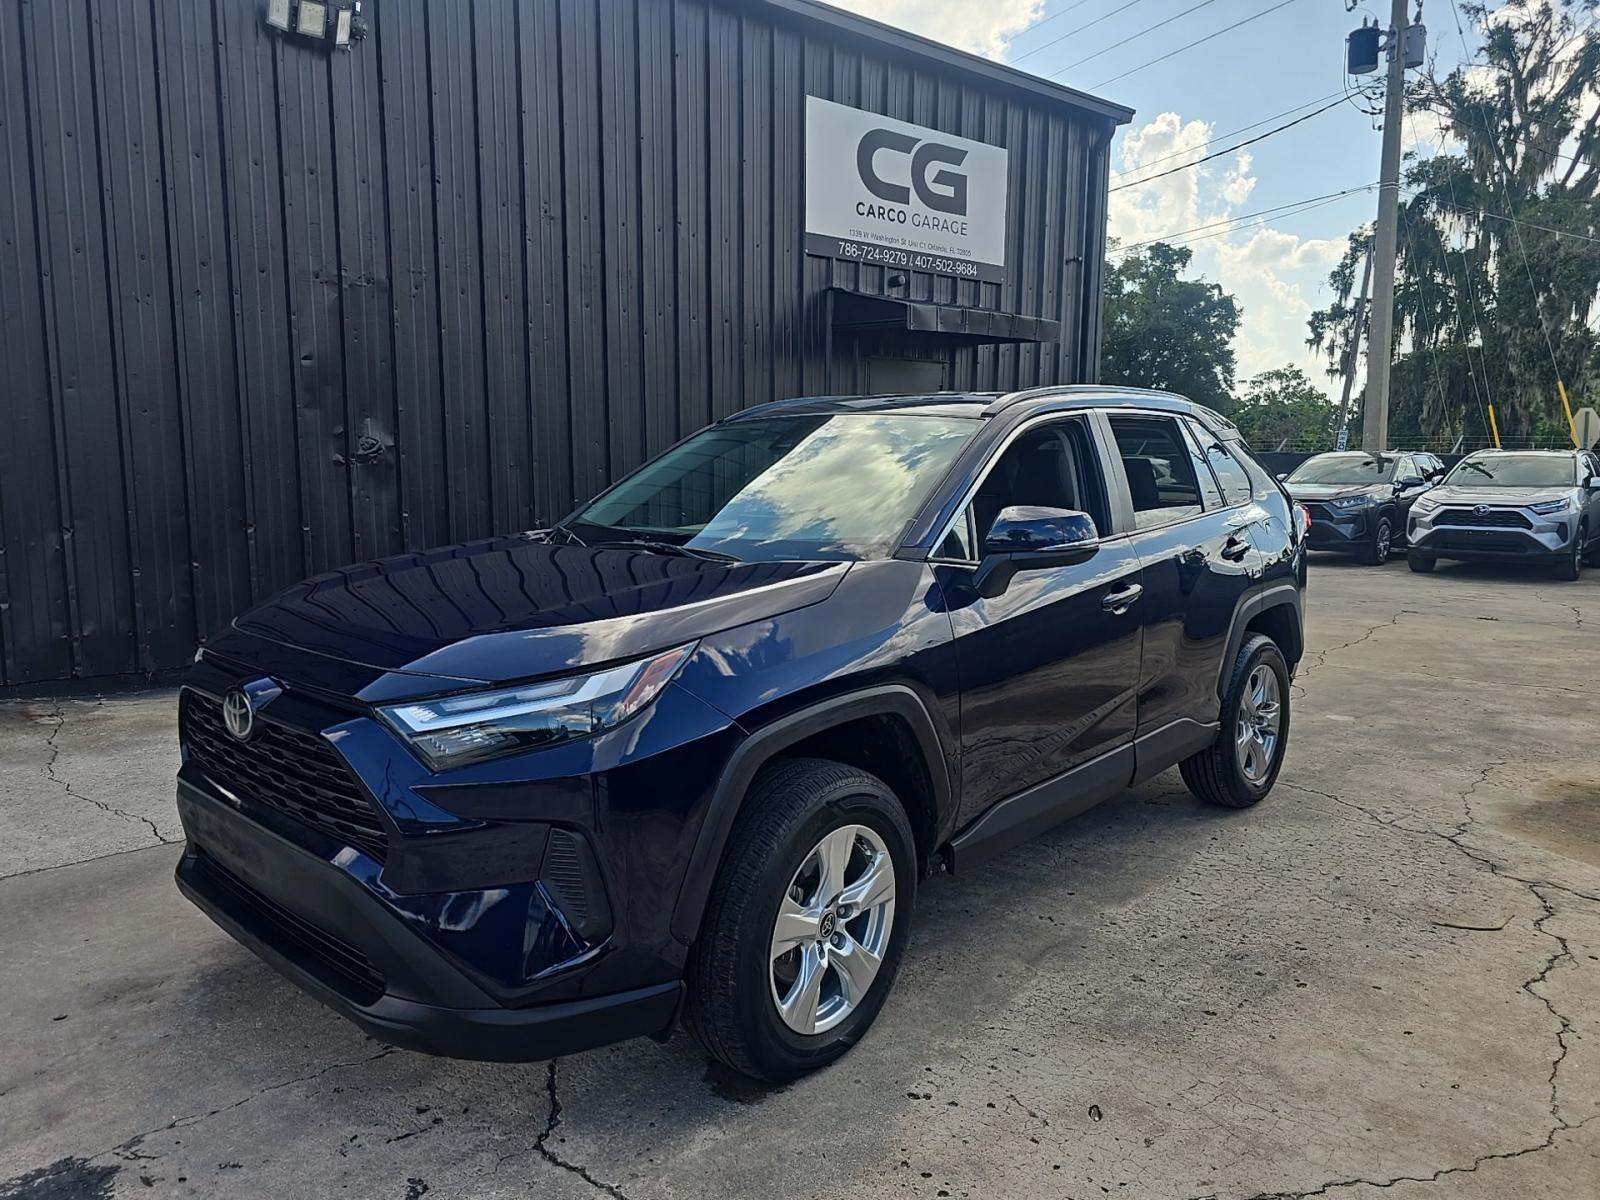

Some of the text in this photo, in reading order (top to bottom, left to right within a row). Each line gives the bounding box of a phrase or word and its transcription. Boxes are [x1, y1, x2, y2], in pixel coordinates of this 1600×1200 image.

[857, 128, 968, 217] CG
[856, 202, 967, 236] CARCO GARAGE
[863, 231, 869, 239] W
[839, 241, 907, 265] 786-724-9279
[915, 255, 977, 276] 407-502-9684
